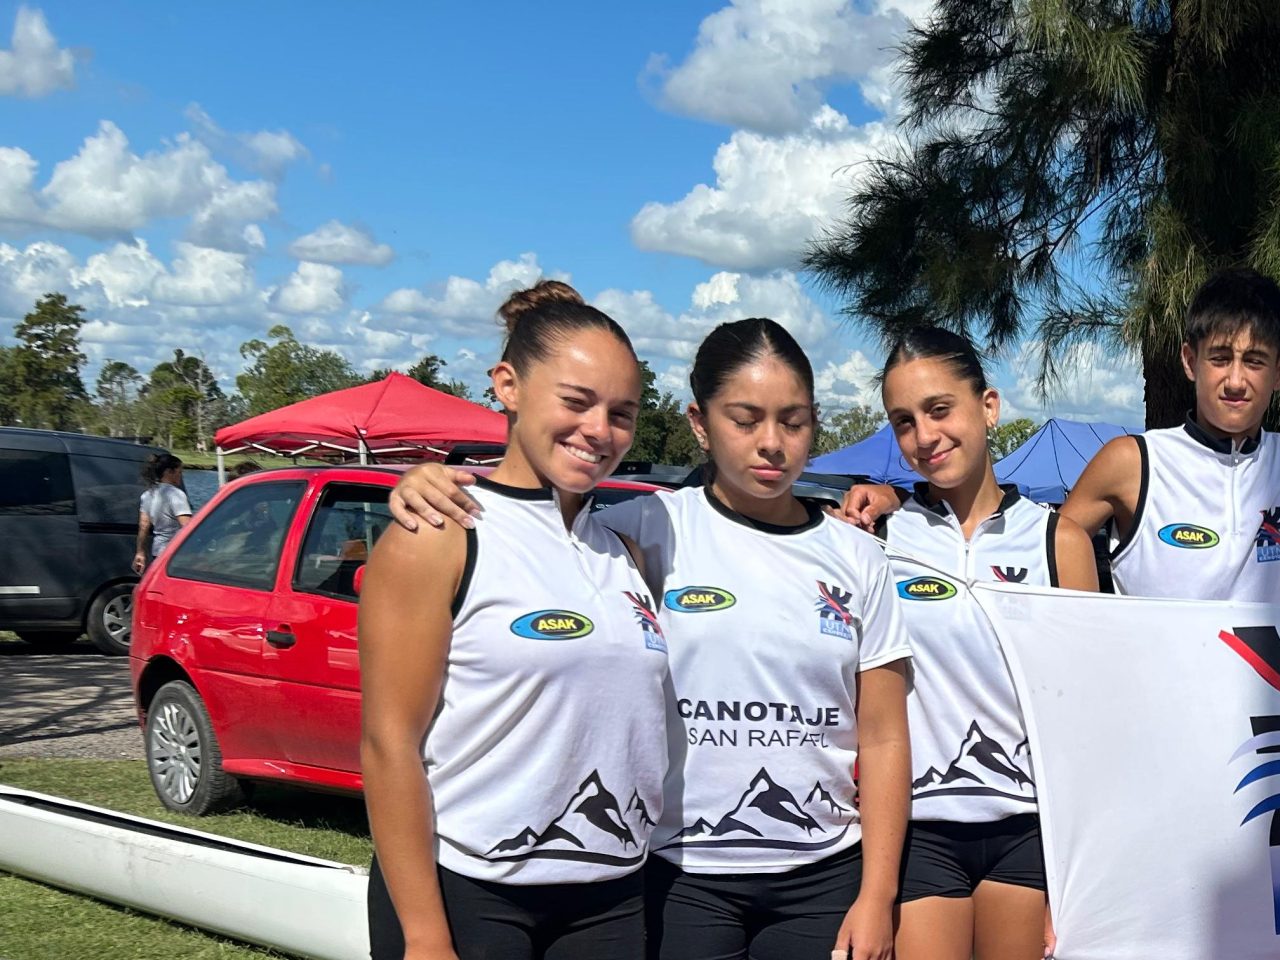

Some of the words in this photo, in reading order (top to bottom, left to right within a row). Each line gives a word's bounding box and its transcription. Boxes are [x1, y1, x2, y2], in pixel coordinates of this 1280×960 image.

[1175, 530, 1205, 542] ASAK
[908, 583, 940, 593] ASAK
[681, 594, 716, 605] ASAK
[537, 618, 577, 631] ASAK
[677, 699, 839, 726] CANOTAJE
[688, 728, 737, 746] SAN
